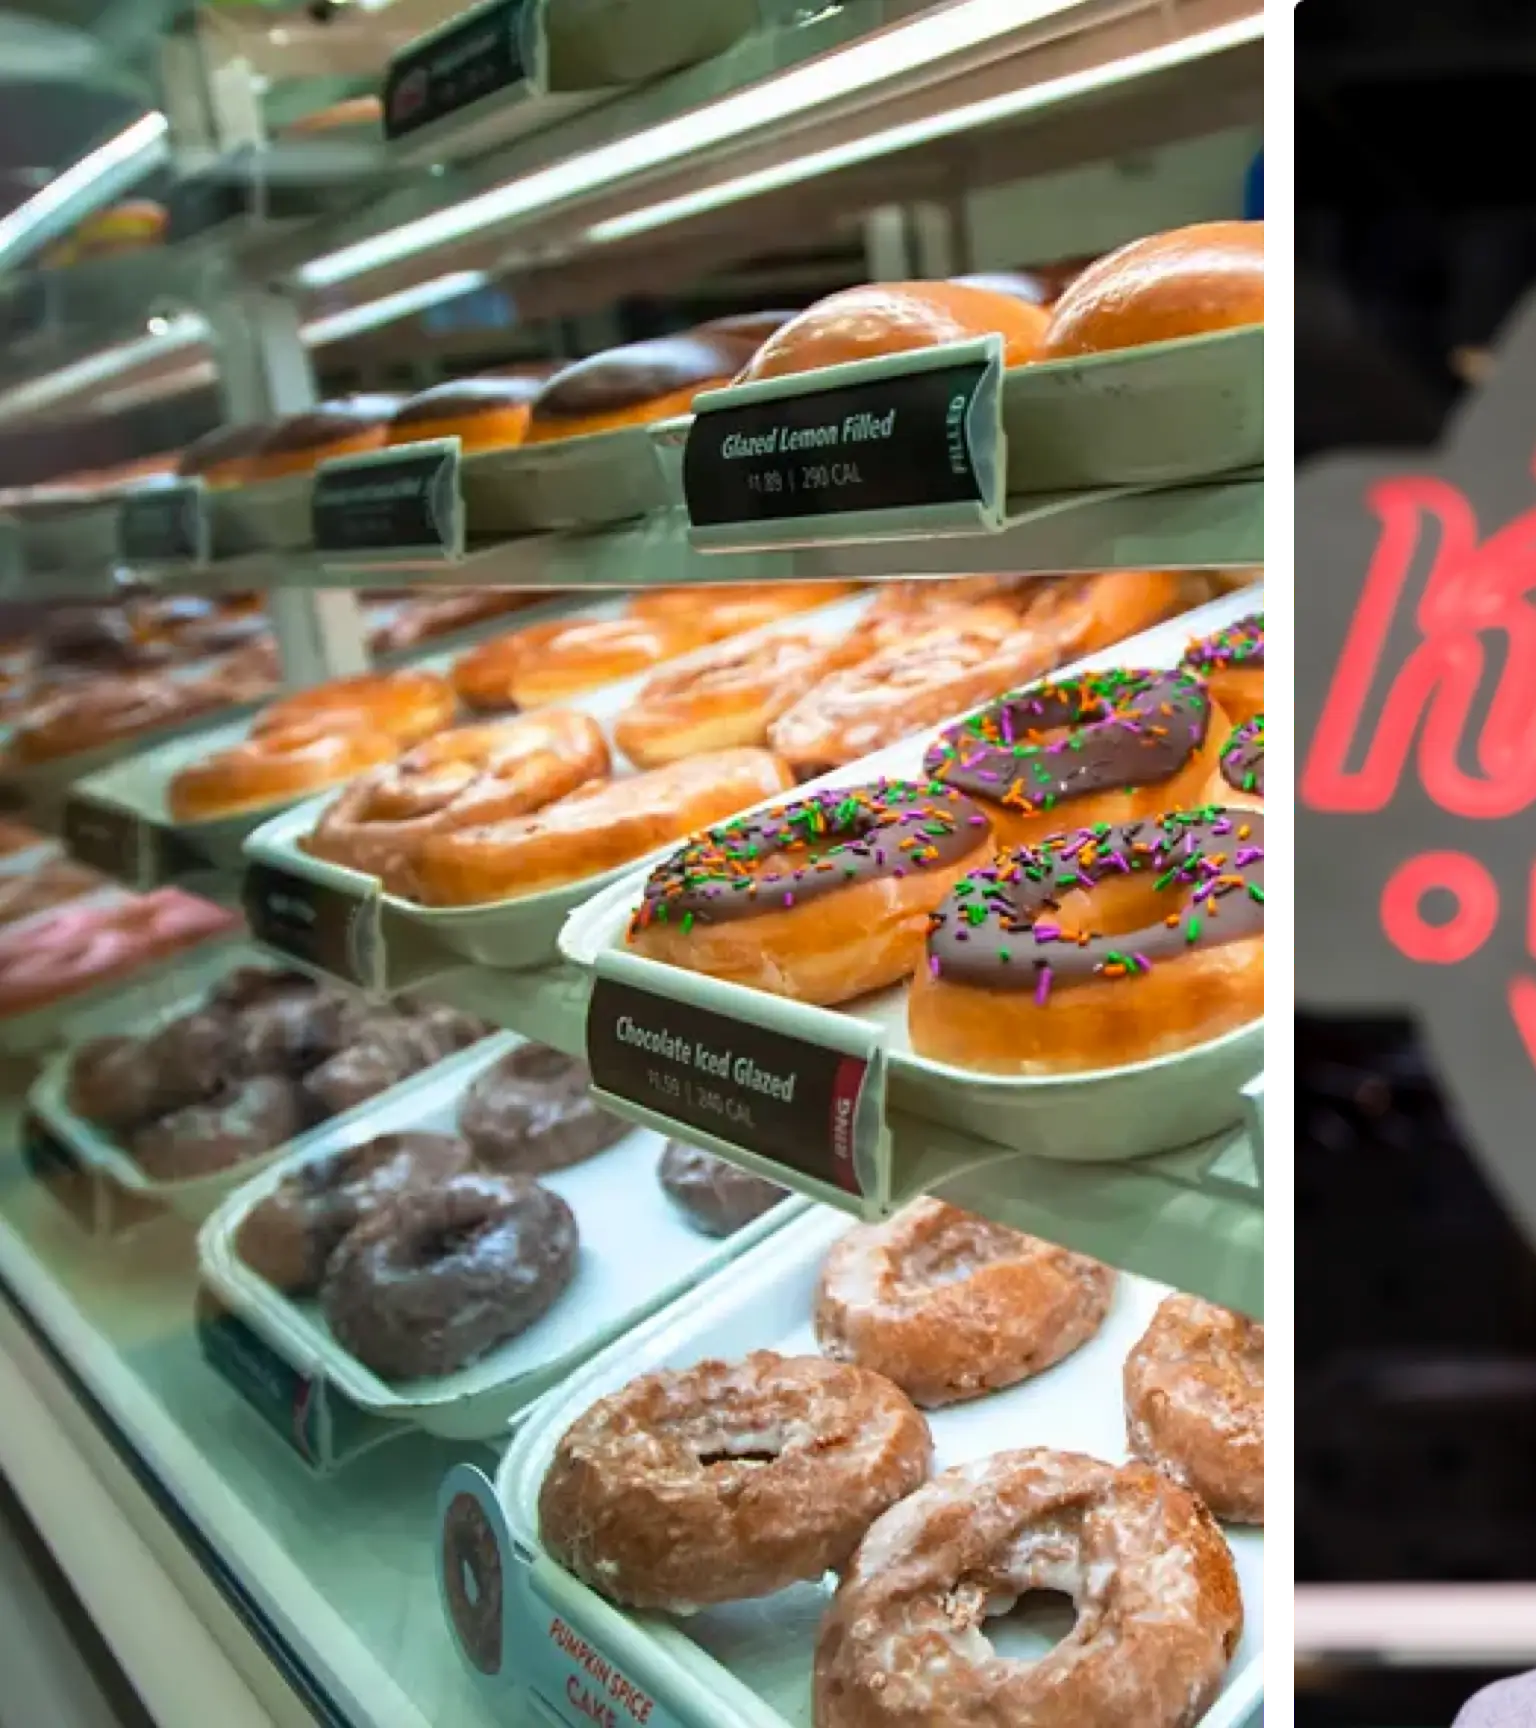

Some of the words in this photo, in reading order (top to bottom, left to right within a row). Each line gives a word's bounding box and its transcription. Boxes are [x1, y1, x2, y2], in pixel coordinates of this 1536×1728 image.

[721, 427, 777, 459] Glazed
[780, 423, 839, 452] Lemon
[842, 408, 896, 443] Filled
[945, 395, 968, 474] FILLED
[802, 464, 829, 489] 290
[832, 461, 864, 486] CAL
[616, 1015, 691, 1065] Chocolate
[694, 1042, 732, 1079] Iced
[734, 1057, 797, 1103] Glazed
[726, 1098, 756, 1128] CAL
[834, 1098, 851, 1159] RING
[549, 1617, 612, 1686] PUMPKIN
[609, 1672, 655, 1726] SPICE
[566, 1674, 618, 1728] CAKE
